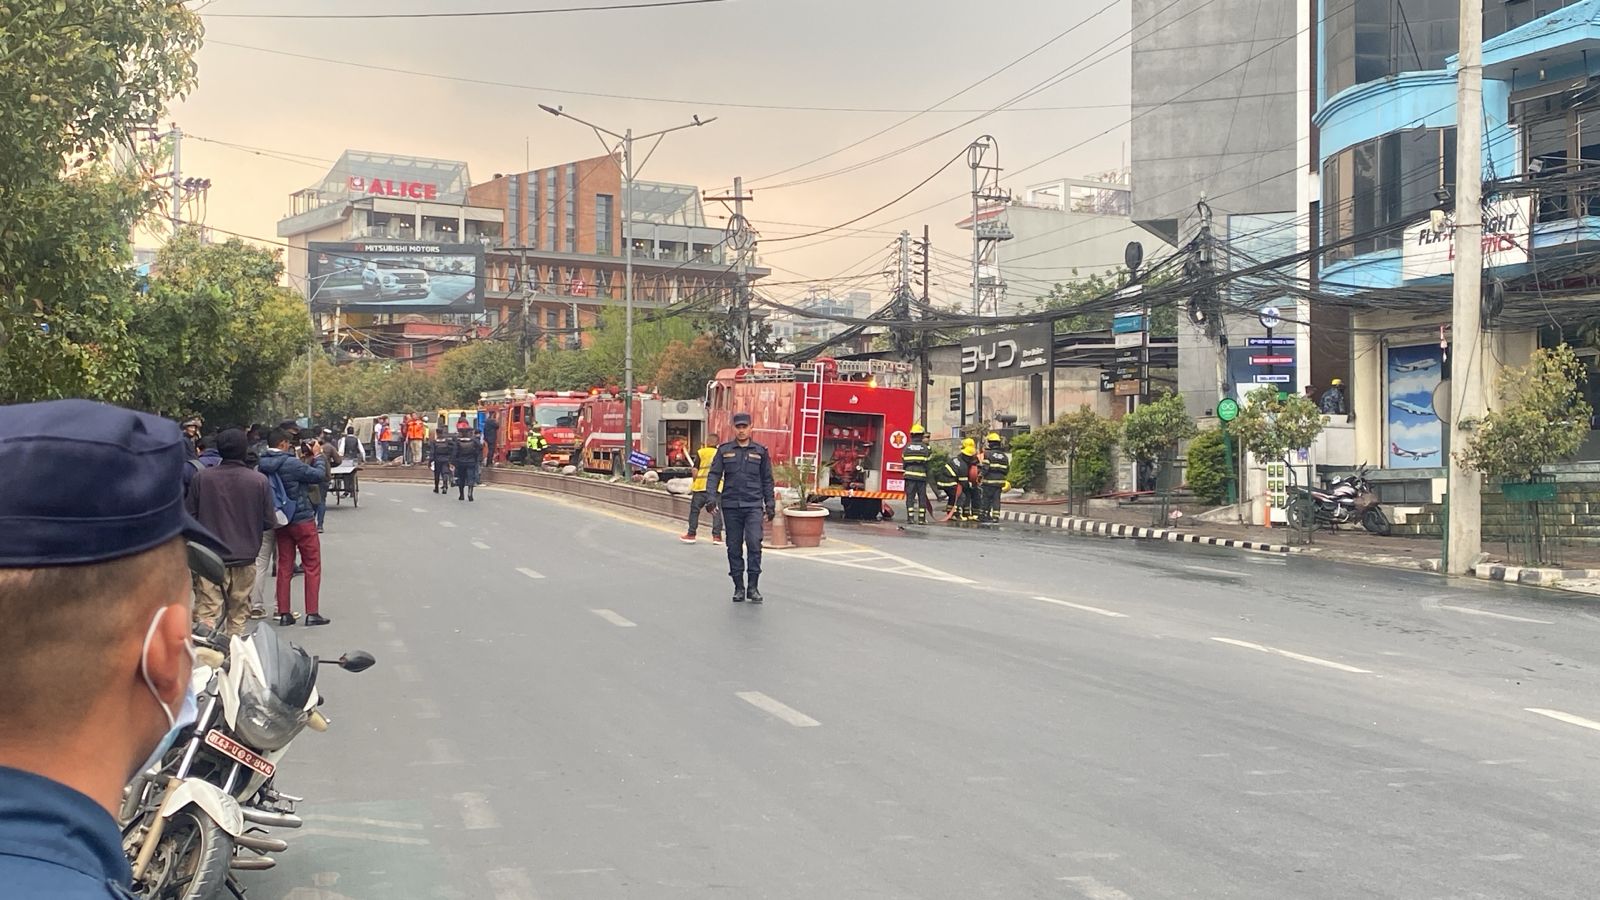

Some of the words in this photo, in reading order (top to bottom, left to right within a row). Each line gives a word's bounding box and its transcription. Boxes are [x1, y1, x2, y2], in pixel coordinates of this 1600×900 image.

[368, 178, 437, 200] ALICE
[365, 244, 408, 252] MITSUBISHI
[408, 245, 440, 253] MOTORS
[962, 340, 1017, 373] BYD
